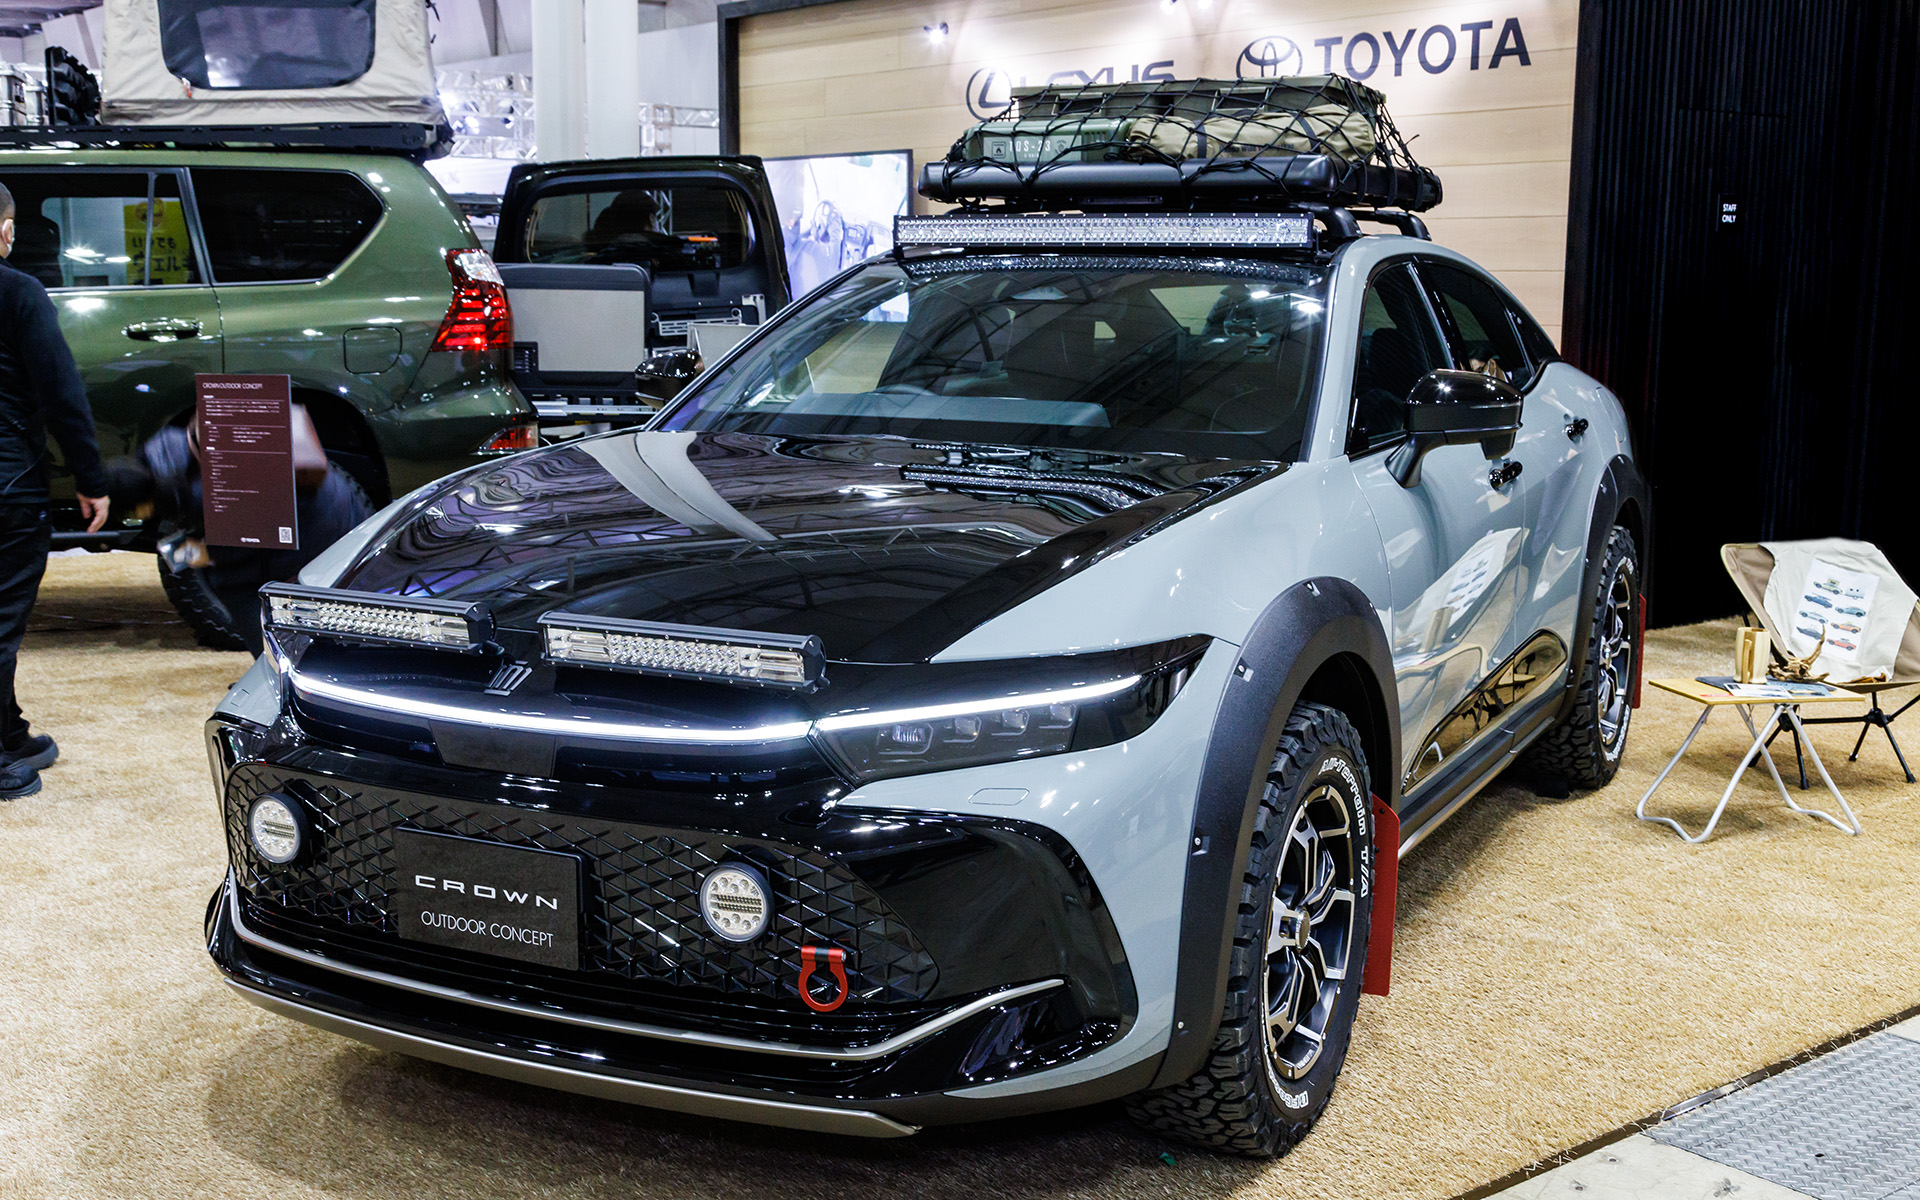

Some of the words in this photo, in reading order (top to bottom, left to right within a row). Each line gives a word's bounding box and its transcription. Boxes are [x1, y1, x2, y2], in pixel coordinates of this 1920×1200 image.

[1314, 17, 1532, 81] TOYOTA
[1722, 203, 1737, 212] STAFF
[1722, 214, 1736, 223] ONLY
[1360, 845, 1369, 898] T/A
[415, 875, 558, 910] CROWN
[421, 911, 487, 936] OUTDOOR
[490, 923, 554, 948] CONCEPT
